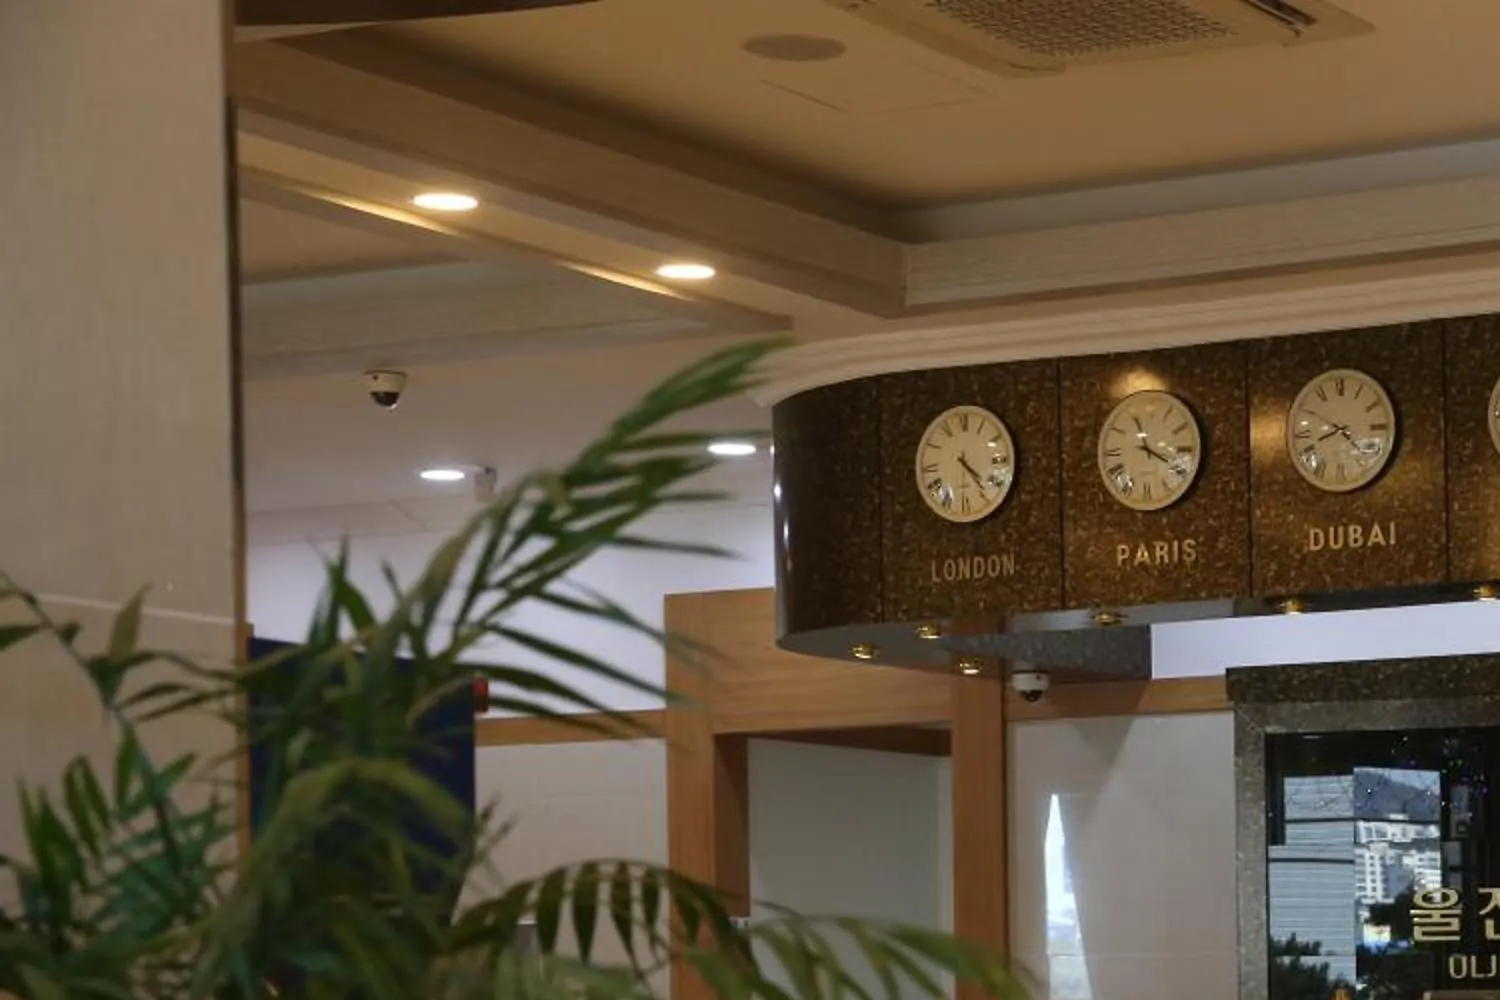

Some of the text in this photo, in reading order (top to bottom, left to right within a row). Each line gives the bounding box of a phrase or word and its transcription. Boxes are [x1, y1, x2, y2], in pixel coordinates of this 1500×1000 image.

[1308, 521, 1397, 551] DUBAI
[930, 552, 1016, 584] LONDON
[1115, 539, 1198, 567] PARIS
